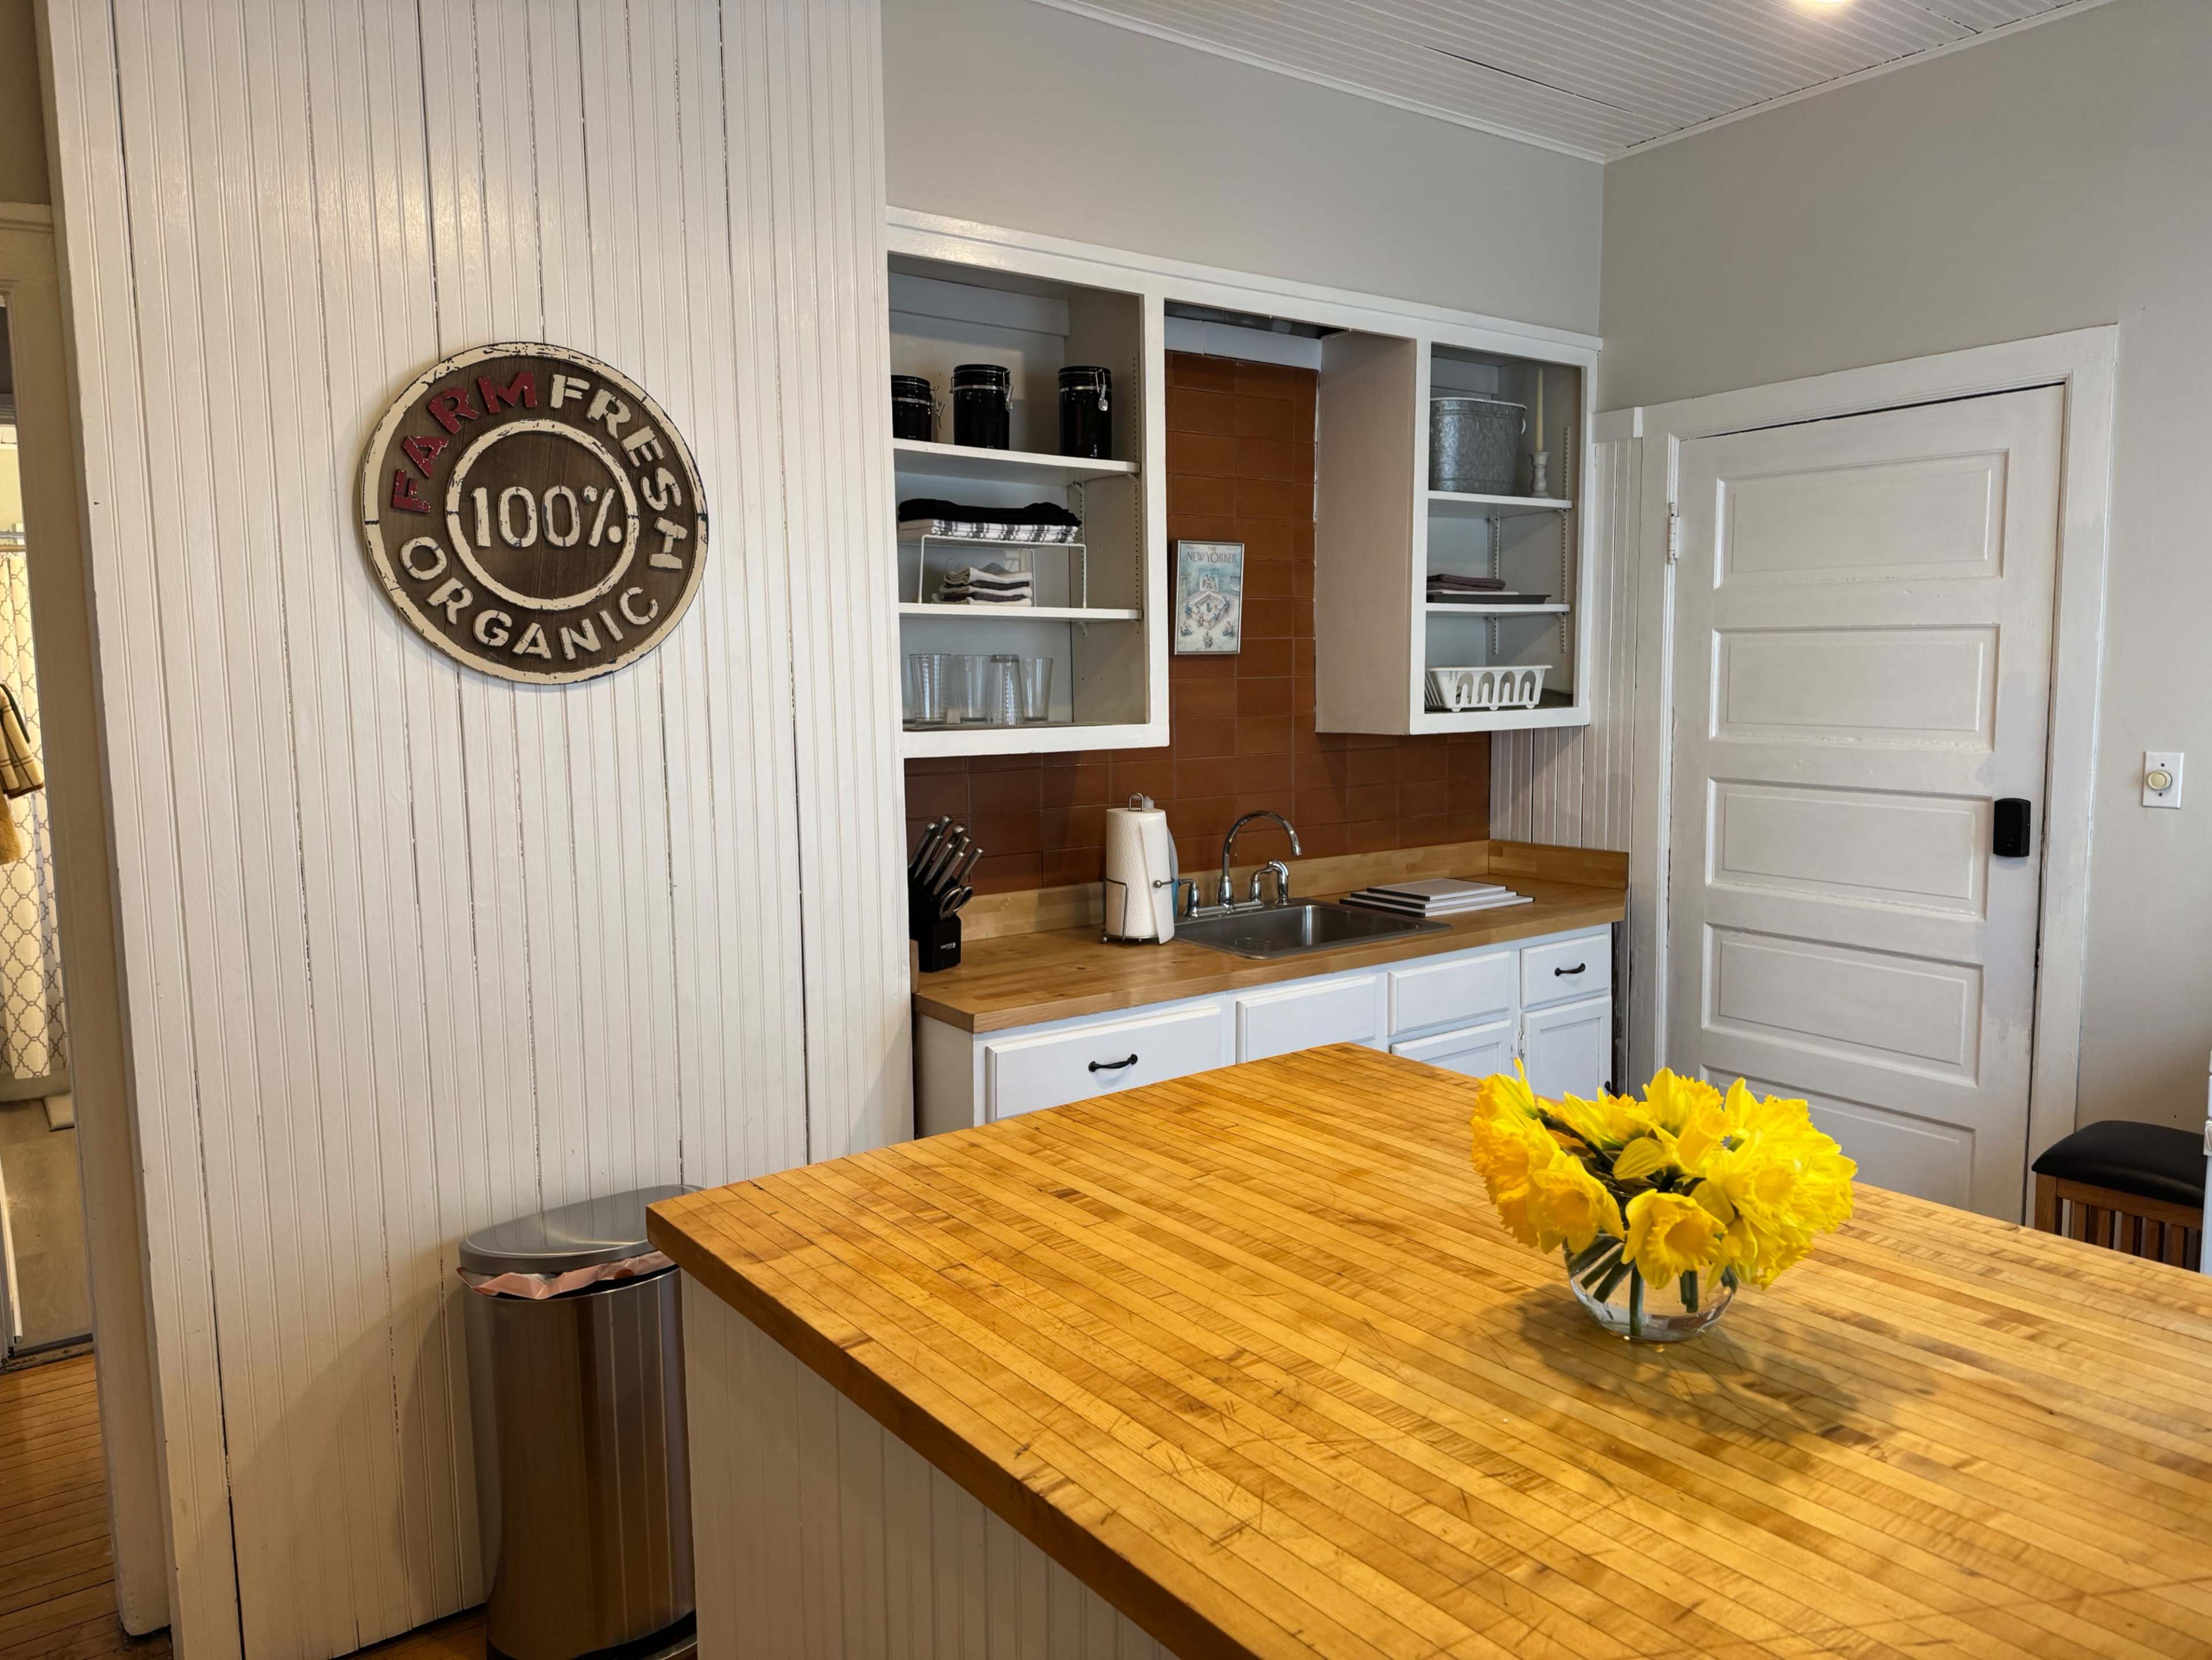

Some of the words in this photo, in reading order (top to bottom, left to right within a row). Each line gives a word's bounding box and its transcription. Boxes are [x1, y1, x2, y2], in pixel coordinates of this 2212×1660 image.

[392, 371, 538, 514] FARM
[550, 373, 688, 570] FRESH
[470, 485, 623, 549] 100%
[400, 536, 659, 660] ORGANIC
[1187, 551, 1205, 562] NEW
[1206, 552, 1237, 563] YORKER
